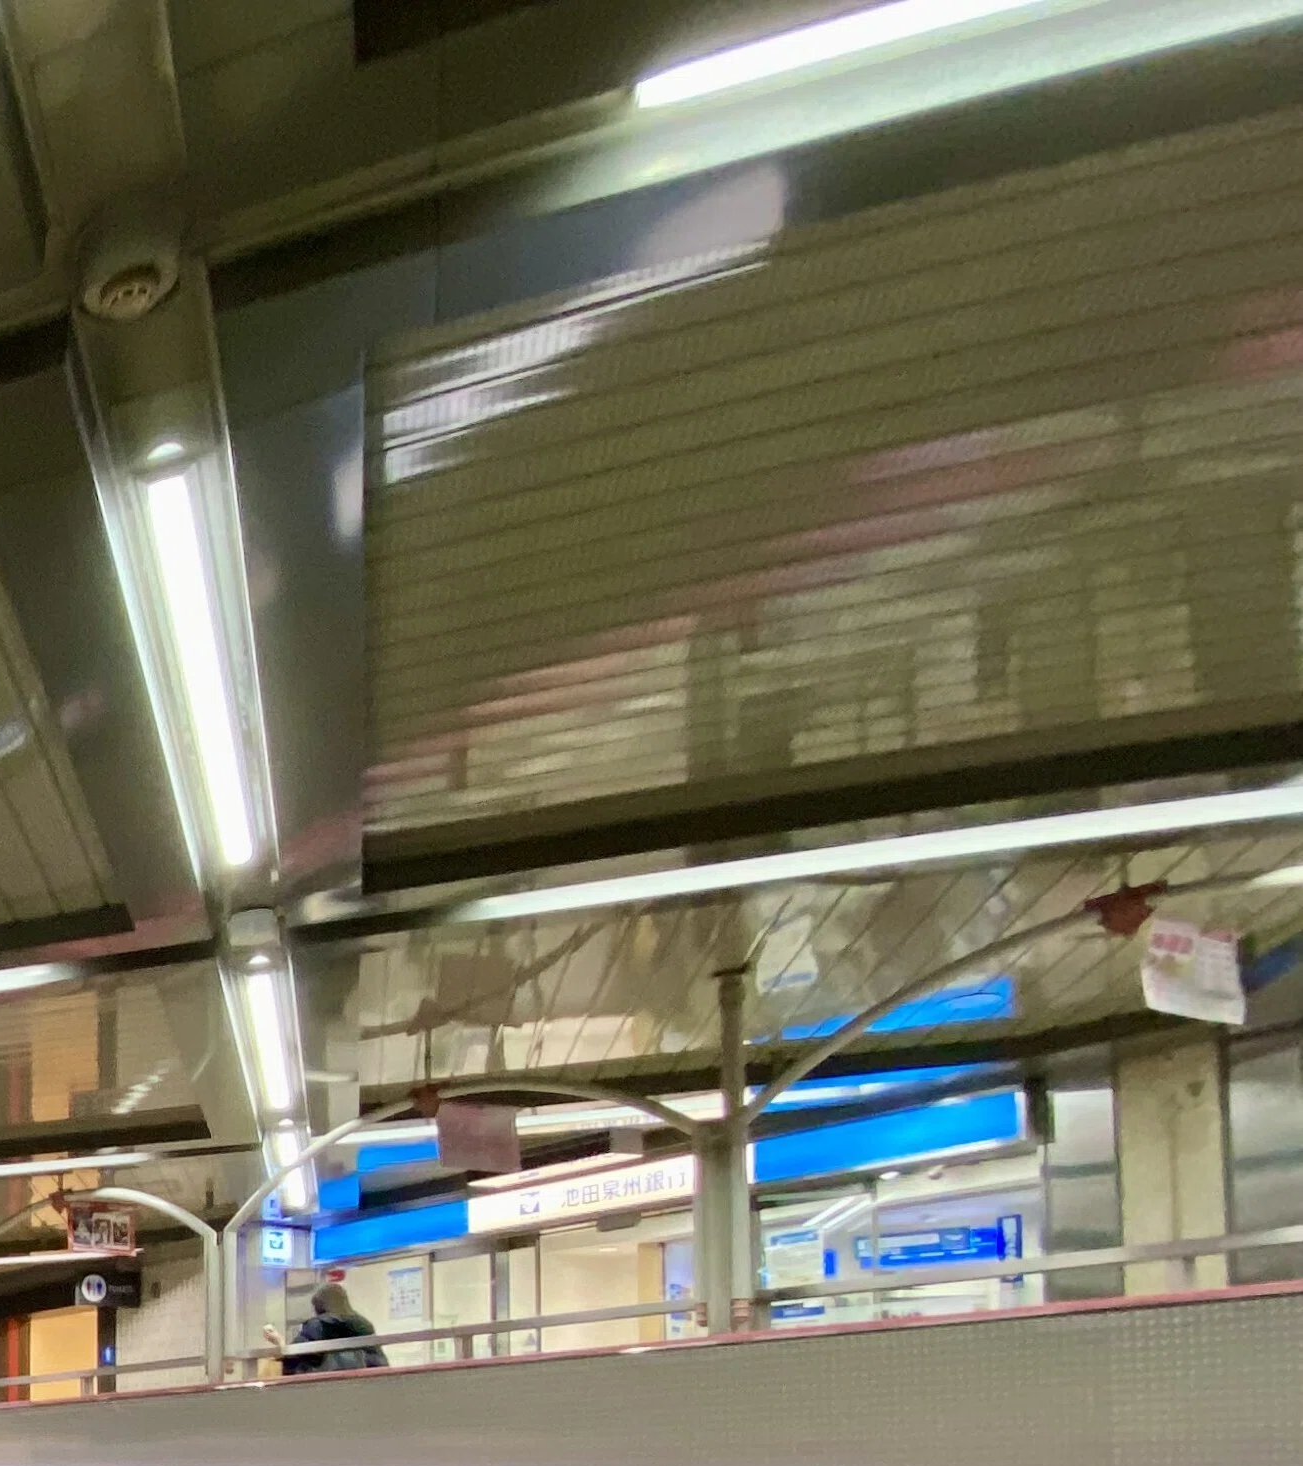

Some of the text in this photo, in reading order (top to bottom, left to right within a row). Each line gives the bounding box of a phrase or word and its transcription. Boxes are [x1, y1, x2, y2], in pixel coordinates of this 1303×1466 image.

[561, 1164, 686, 1208] 池田泉州銀行
